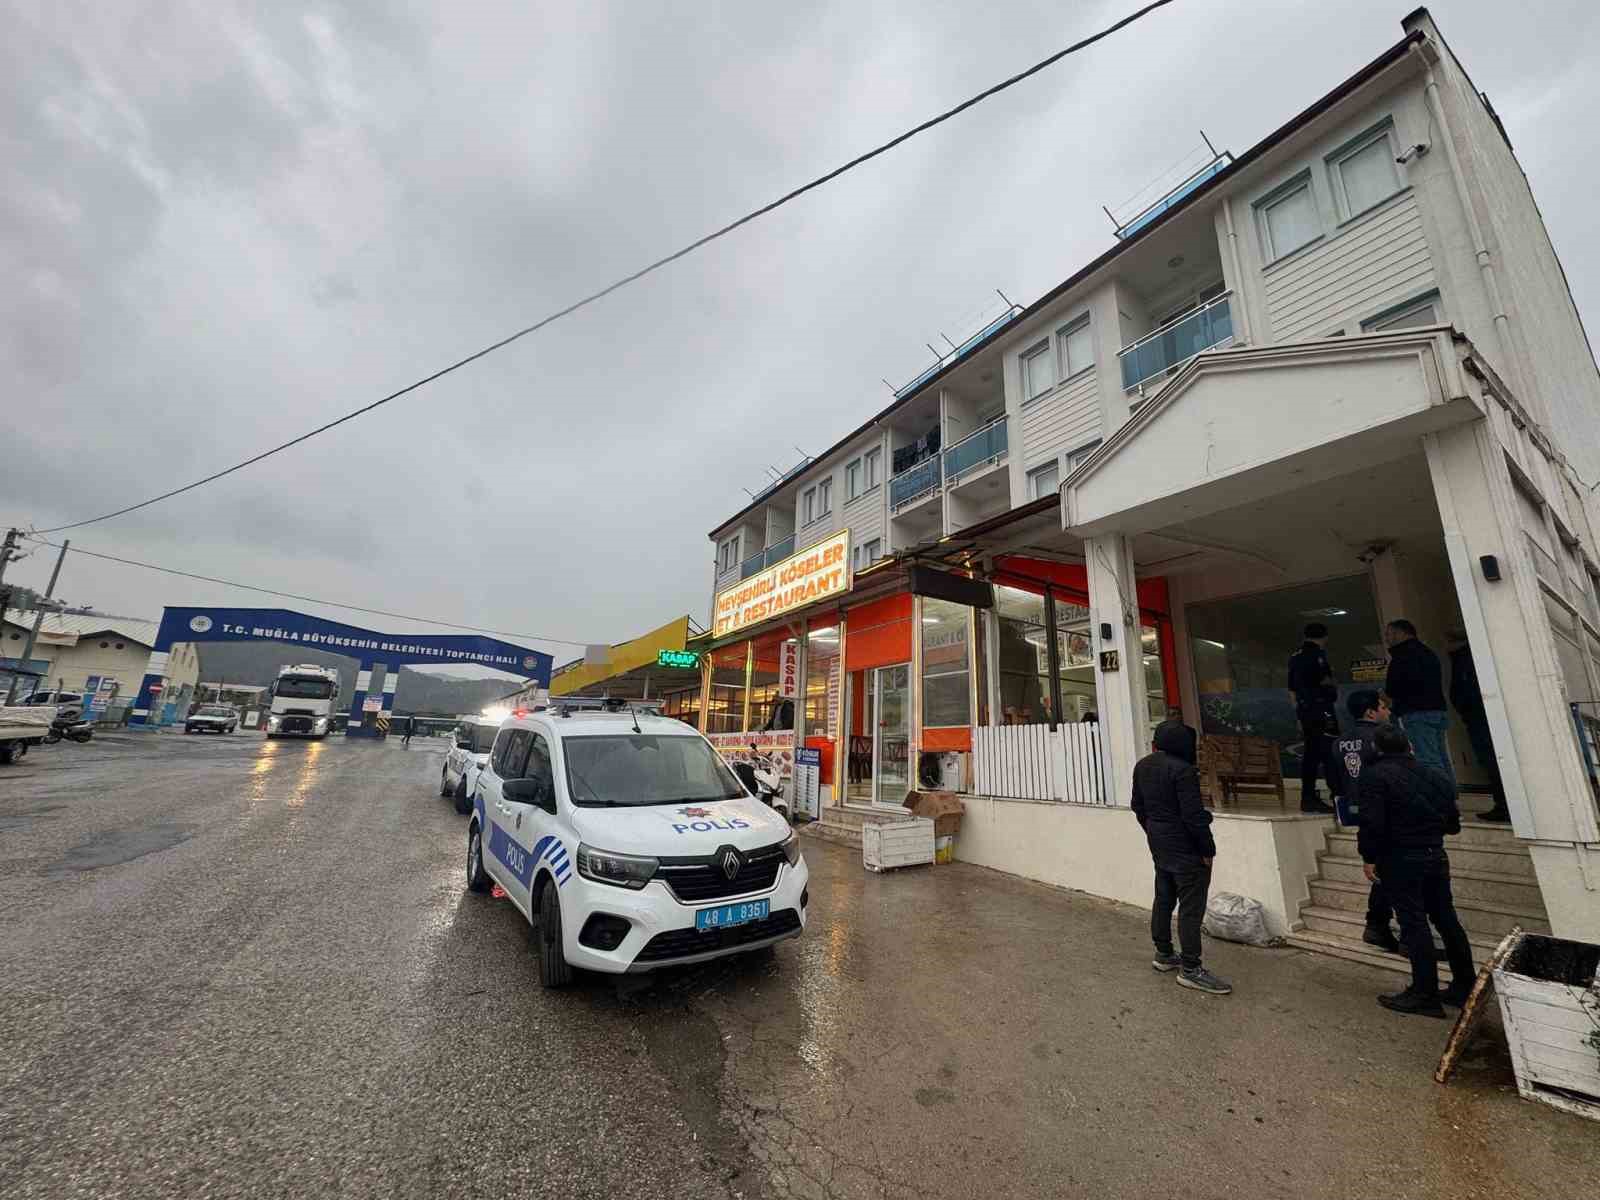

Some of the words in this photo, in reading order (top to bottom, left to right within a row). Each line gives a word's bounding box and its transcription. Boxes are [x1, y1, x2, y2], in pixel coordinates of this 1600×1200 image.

[780, 543, 844, 586] KÖSELER
[717, 615, 731, 633] ET
[743, 569, 842, 623] RESTAURANT
[223, 624, 248, 636] T.C.
[252, 627, 299, 641] MUĞLA
[381, 643, 443, 657] BELEDİYESİ
[446, 650, 493, 662] TOPTANCI
[496, 656, 518, 665] HALİ
[661, 652, 696, 665] KASAP
[784, 644, 795, 697] KASAP
[671, 818, 750, 834] POLİS
[705, 910, 719, 925] 48
[726, 906, 734, 922] A
